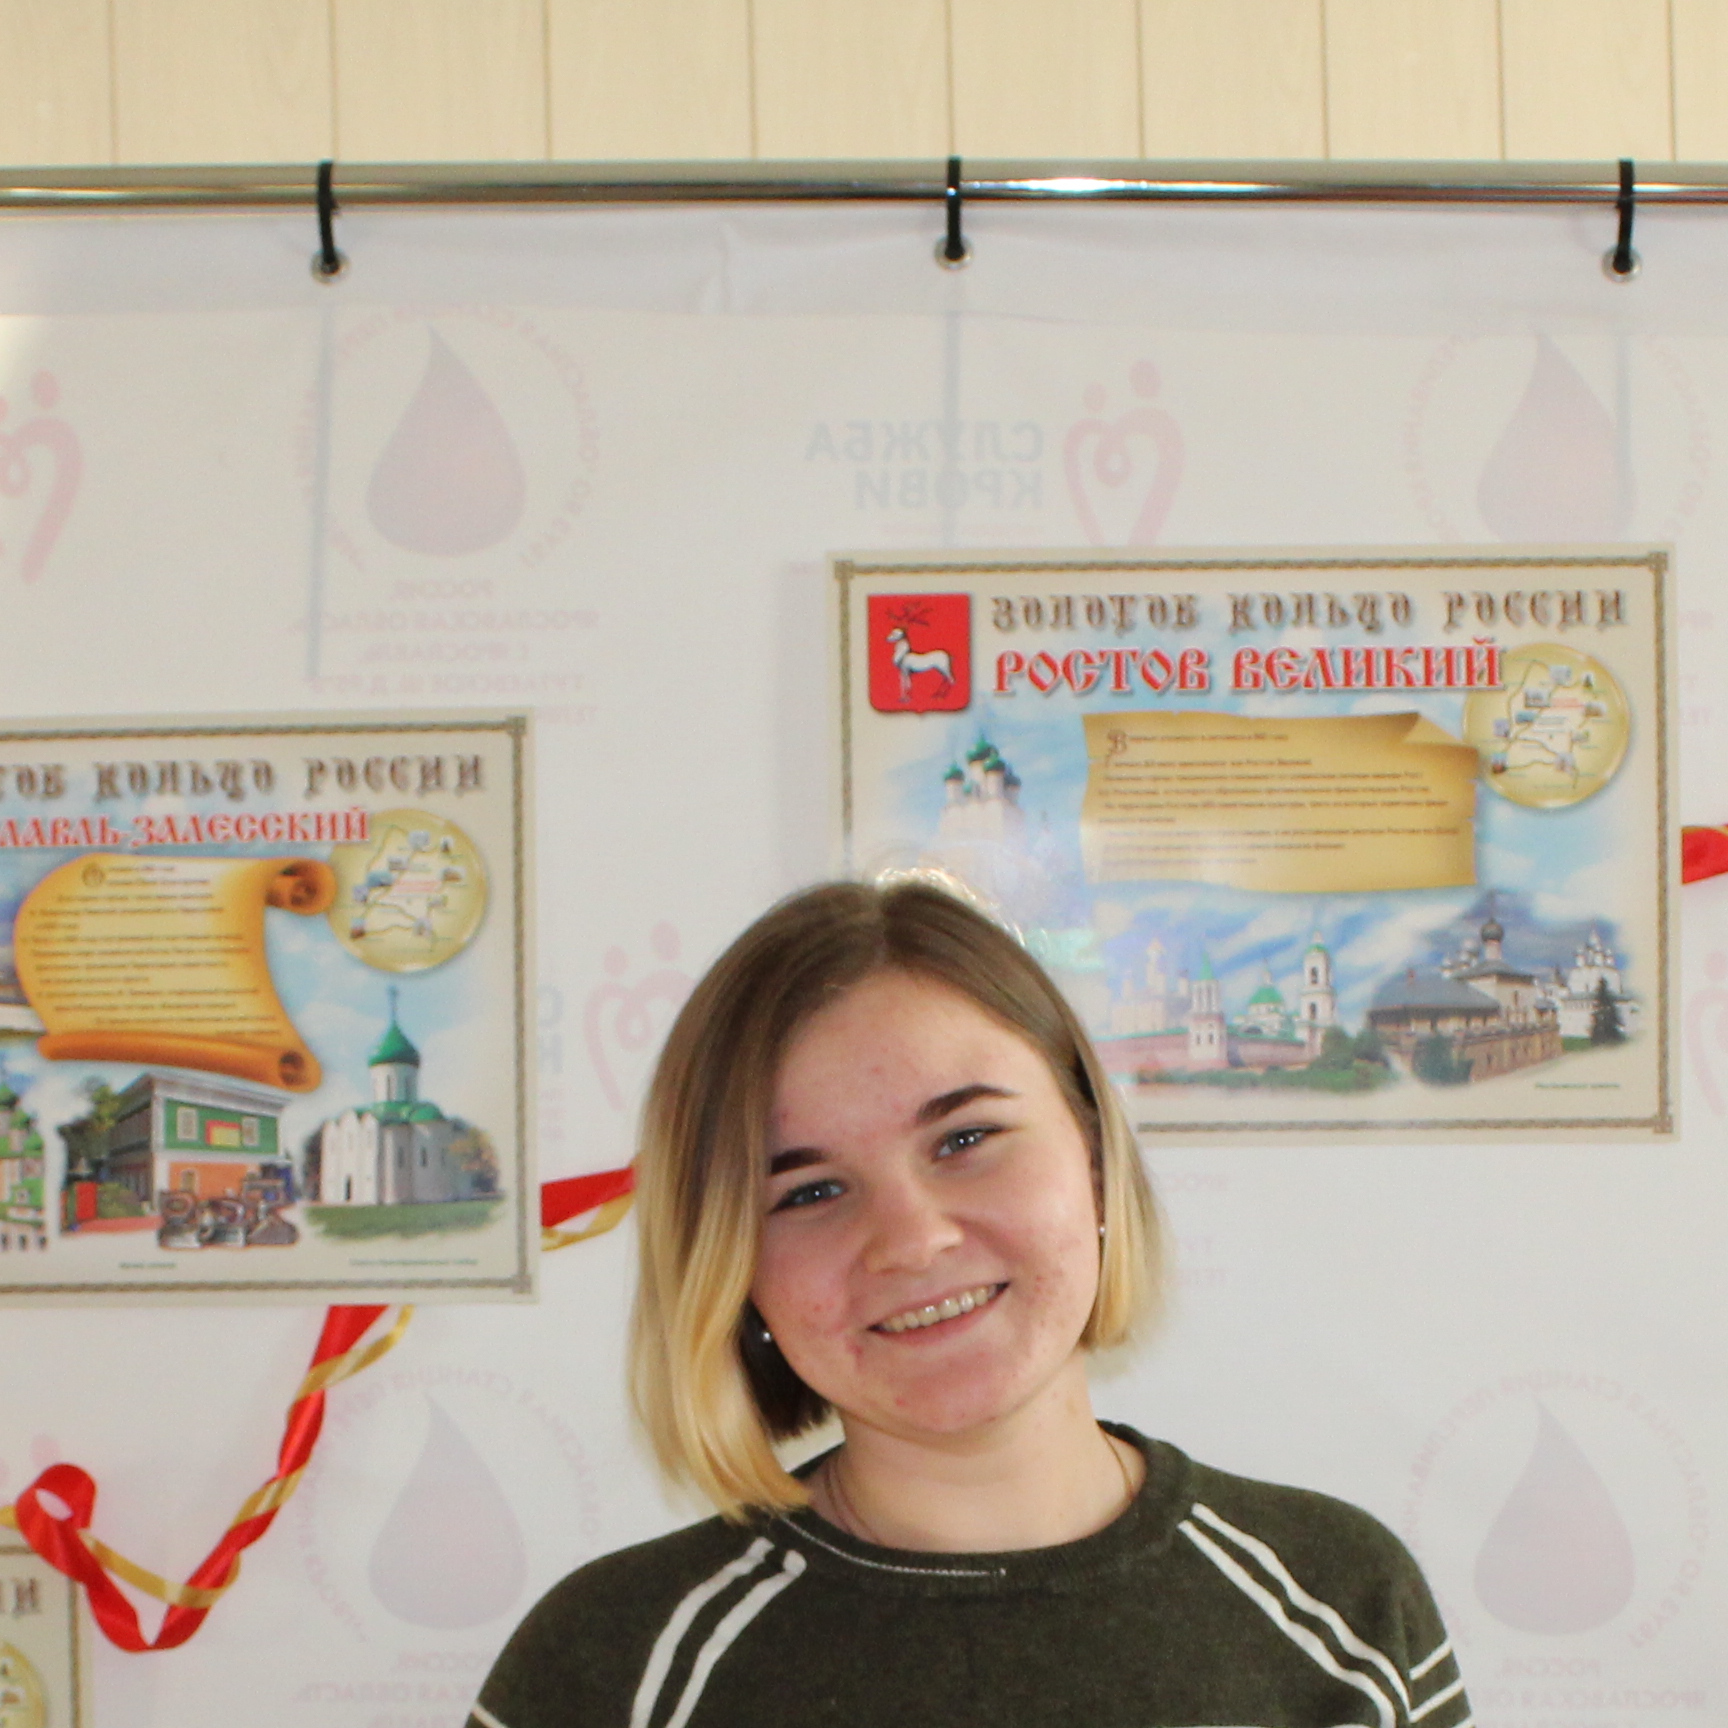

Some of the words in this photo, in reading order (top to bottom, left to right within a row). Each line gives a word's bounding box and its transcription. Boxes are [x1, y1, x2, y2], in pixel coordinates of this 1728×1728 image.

[993, 594, 1200, 632] ЗОЛОТОЕ
[1228, 592, 1414, 635] КОЛЬЦО
[1441, 590, 1629, 634] РОССИИ
[993, 646, 1210, 697] РОСТОВ
[1232, 636, 1507, 693] ВЕЛИКИЙ
[94, 760, 276, 803] КОЛЬЦО
[303, 755, 487, 799] РОССИИ
